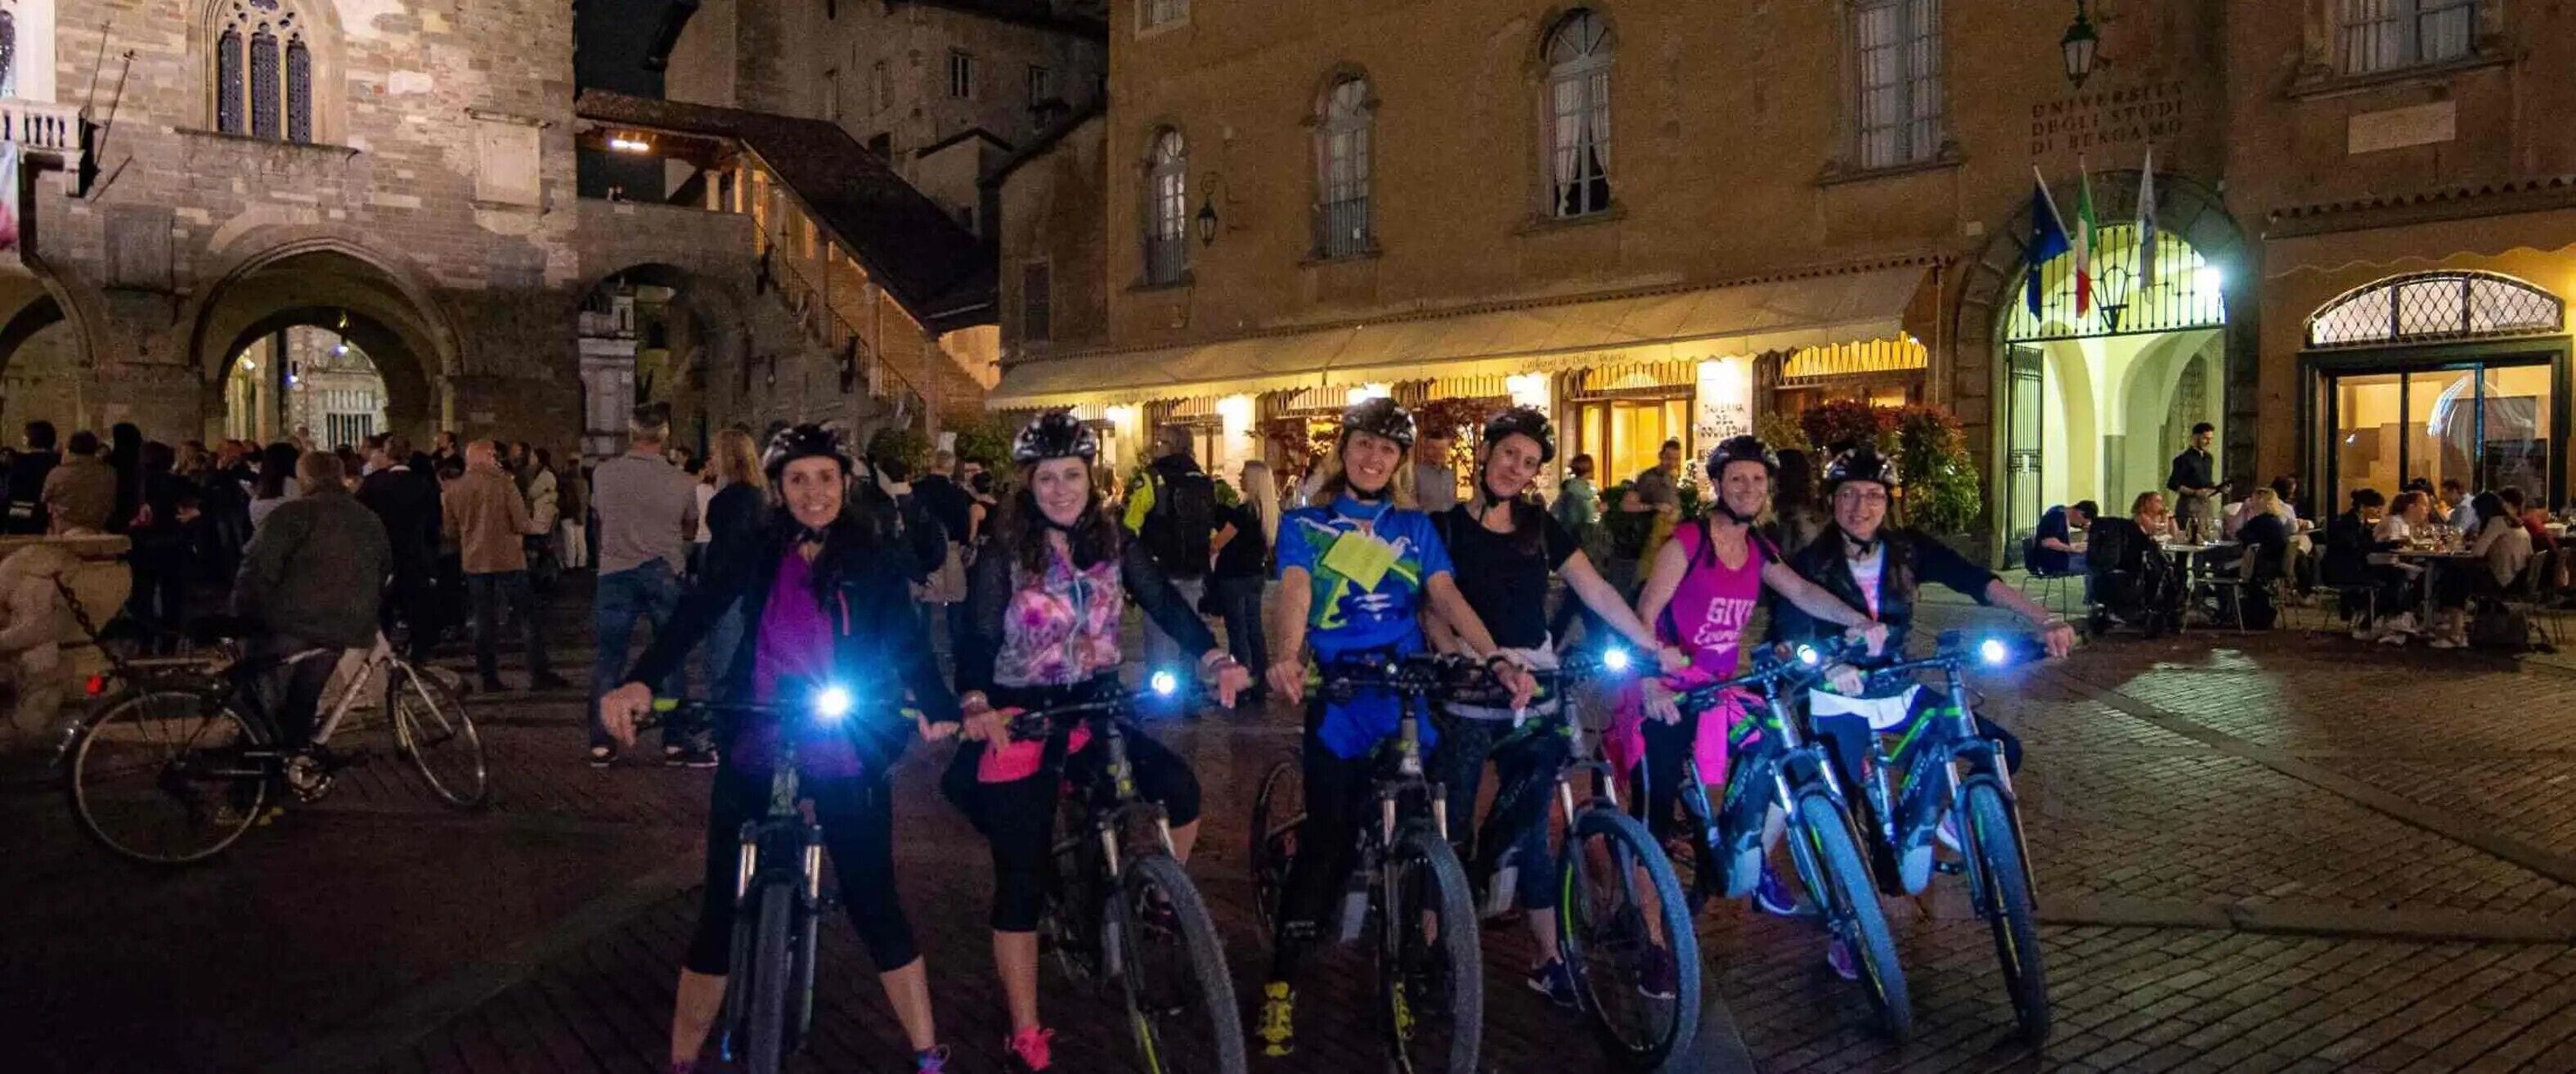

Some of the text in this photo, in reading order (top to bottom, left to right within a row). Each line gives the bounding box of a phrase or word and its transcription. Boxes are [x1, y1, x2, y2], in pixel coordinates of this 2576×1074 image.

[2032, 99, 2183, 136] DEGLI STUDI
[2032, 119, 2183, 155] DI BERGAMO
